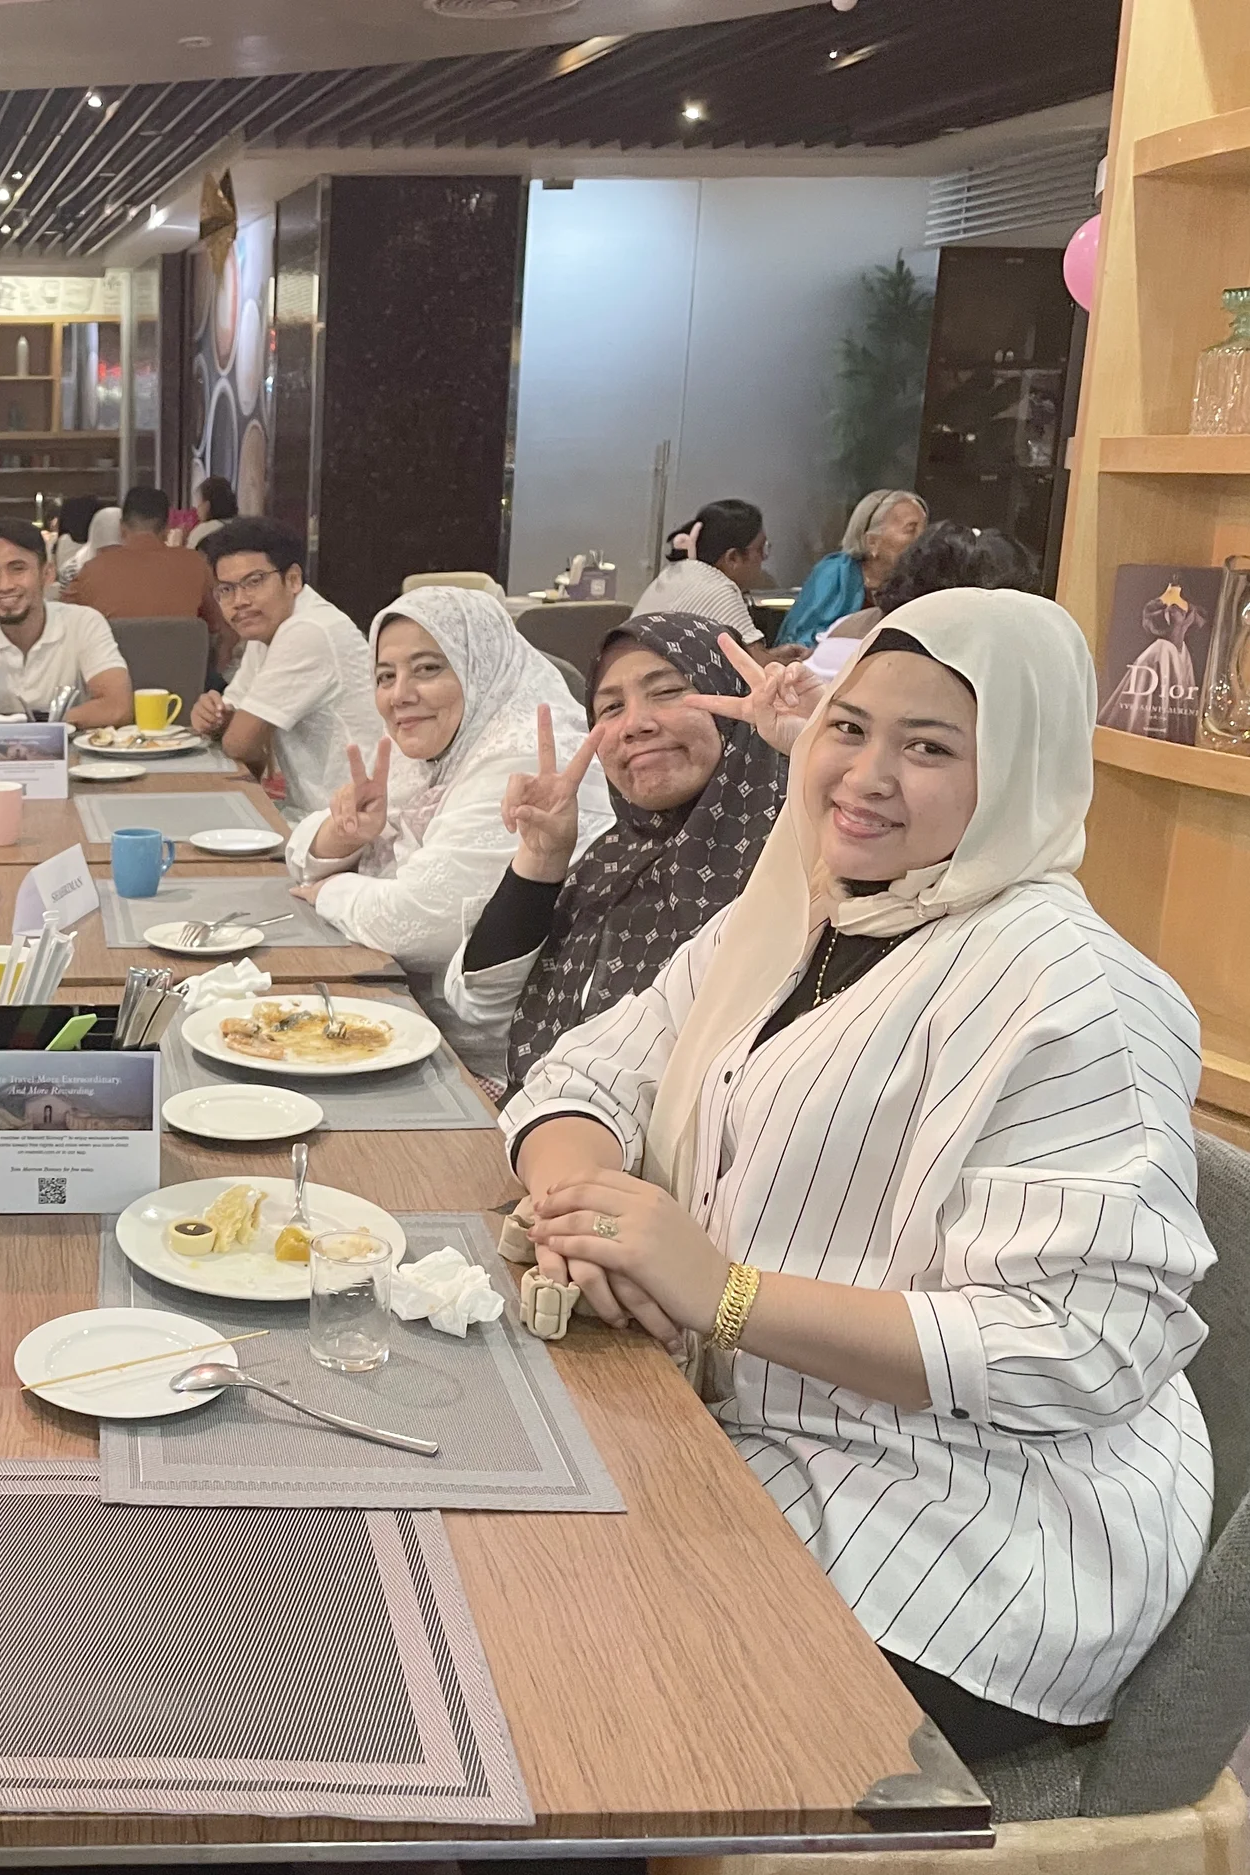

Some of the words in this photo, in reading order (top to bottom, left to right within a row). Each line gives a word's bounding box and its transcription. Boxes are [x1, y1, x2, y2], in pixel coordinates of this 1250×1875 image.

[1121, 664, 1199, 700] Dior
[10, 1075, 35, 1084] Travel
[37, 1075, 60, 1084] More
[61, 1075, 122, 1085] Extraordinary.
[9, 1086, 27, 1095] And
[28, 1086, 49, 1095] More
[50, 1086, 95, 1097] Rewarding.
